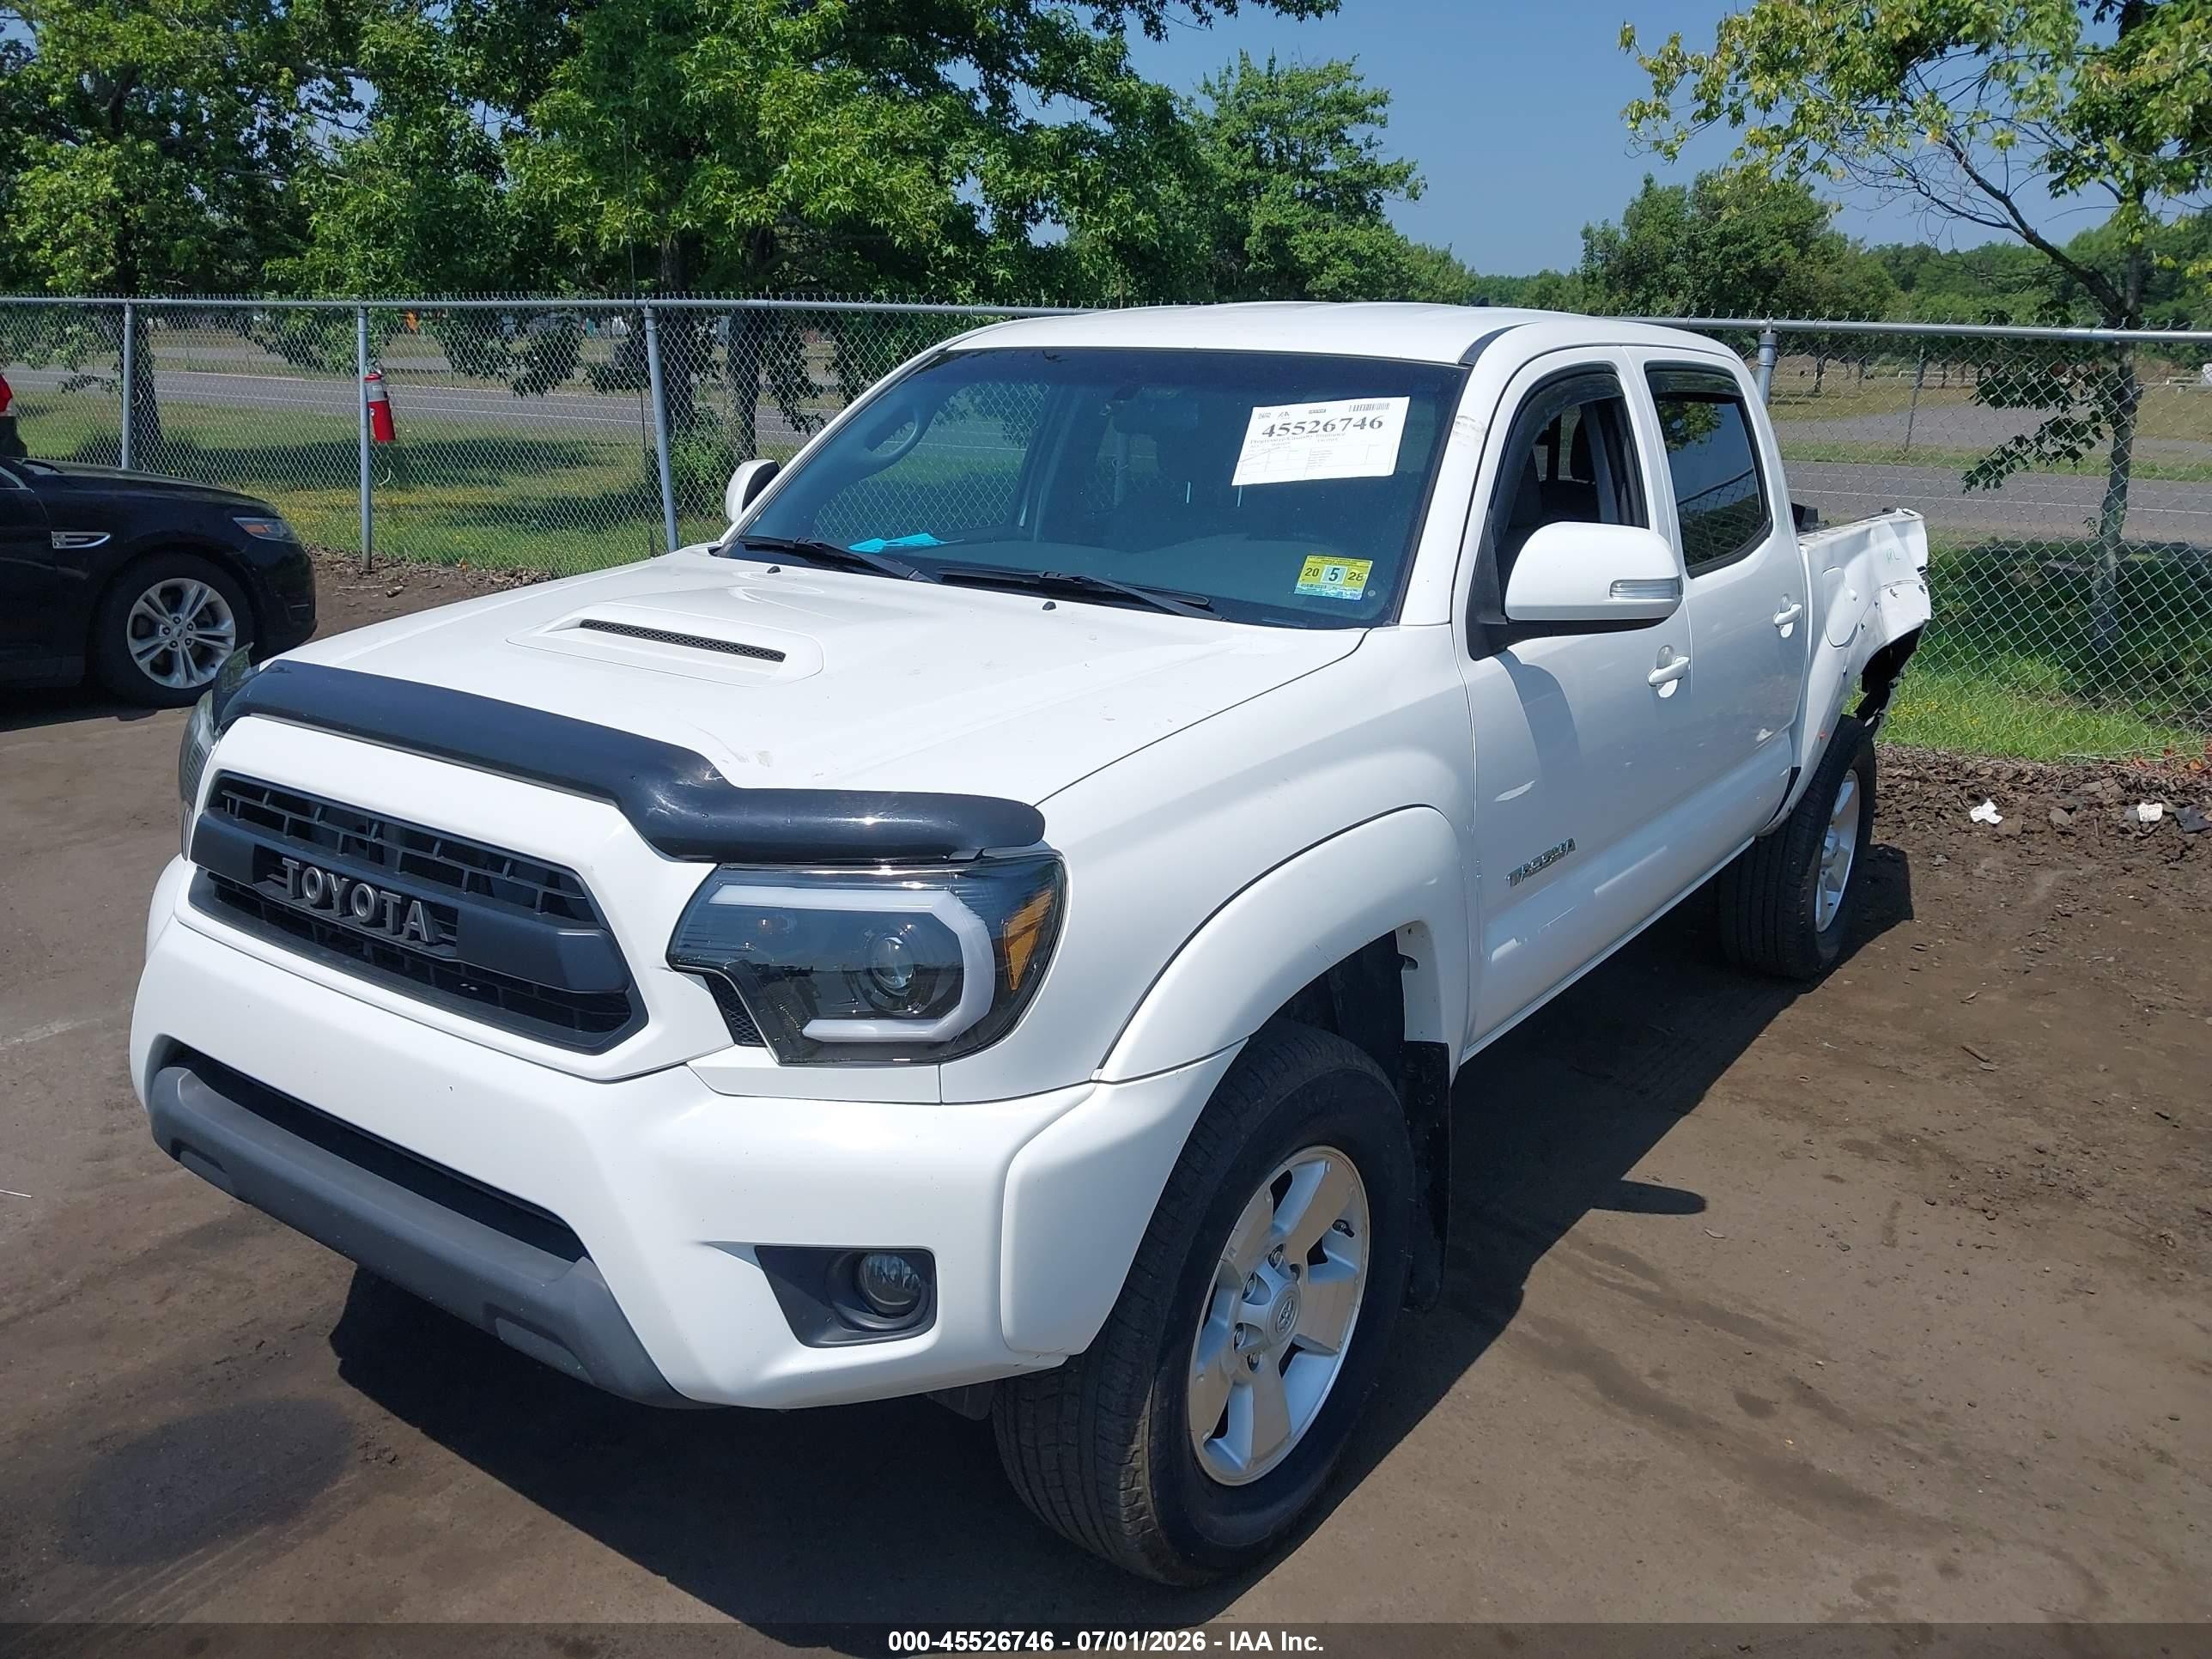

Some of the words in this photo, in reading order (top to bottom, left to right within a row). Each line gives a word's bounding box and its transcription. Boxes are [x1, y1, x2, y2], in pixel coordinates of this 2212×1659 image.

[1262, 415, 1384, 437] 45526746
[1304, 567, 1320, 577] 20
[1328, 567, 1340, 581] 5
[282, 857, 433, 943] TOYOTA
